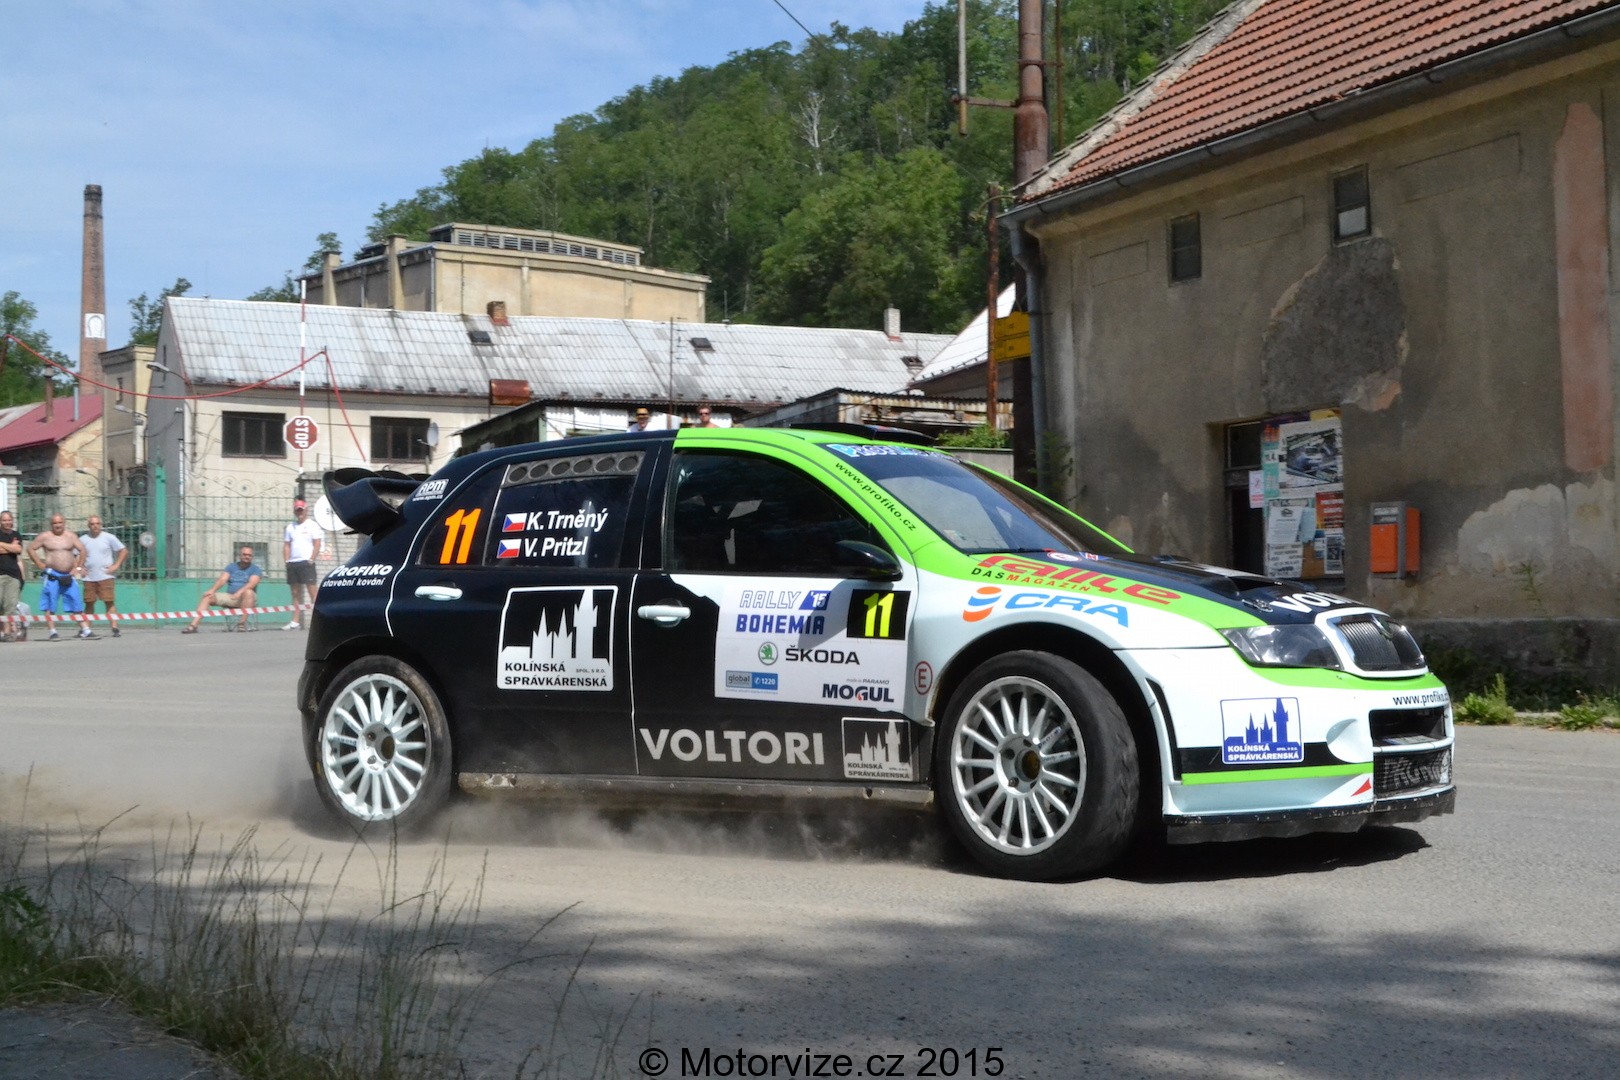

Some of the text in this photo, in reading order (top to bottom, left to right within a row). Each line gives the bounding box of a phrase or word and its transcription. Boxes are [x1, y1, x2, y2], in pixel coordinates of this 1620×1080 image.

[294, 418, 310, 449] STOP
[835, 462, 917, 532] www.profiko.cz
[526, 507, 608, 532] K. Trněný
[439, 508, 482, 565] 11
[524, 536, 589, 558] V. Pritzl
[322, 577, 386, 588] stavební kování
[971, 567, 1091, 592] DAS MAGAZIN
[739, 590, 801, 609] RALLY
[863, 592, 895, 638] 11
[1005, 593, 1130, 628] CRA
[735, 614, 825, 635] BOHEMIA
[785, 645, 860, 665] ŠKODA
[504, 661, 566, 672] KOLÍNSKÁ
[504, 674, 608, 687] SPRÁVKÁRENSKÁ
[728, 673, 776, 686] global 1220
[917, 668, 927, 688] E
[822, 683, 895, 702] MOGUL
[639, 728, 825, 765] VOLTORI
[1227, 743, 1270, 753] KOLÍNSKÁ
[1227, 751, 1300, 761] SPRÁVKÁRENSKÁ
[847, 762, 883, 770] KOLÍNSKÁ
